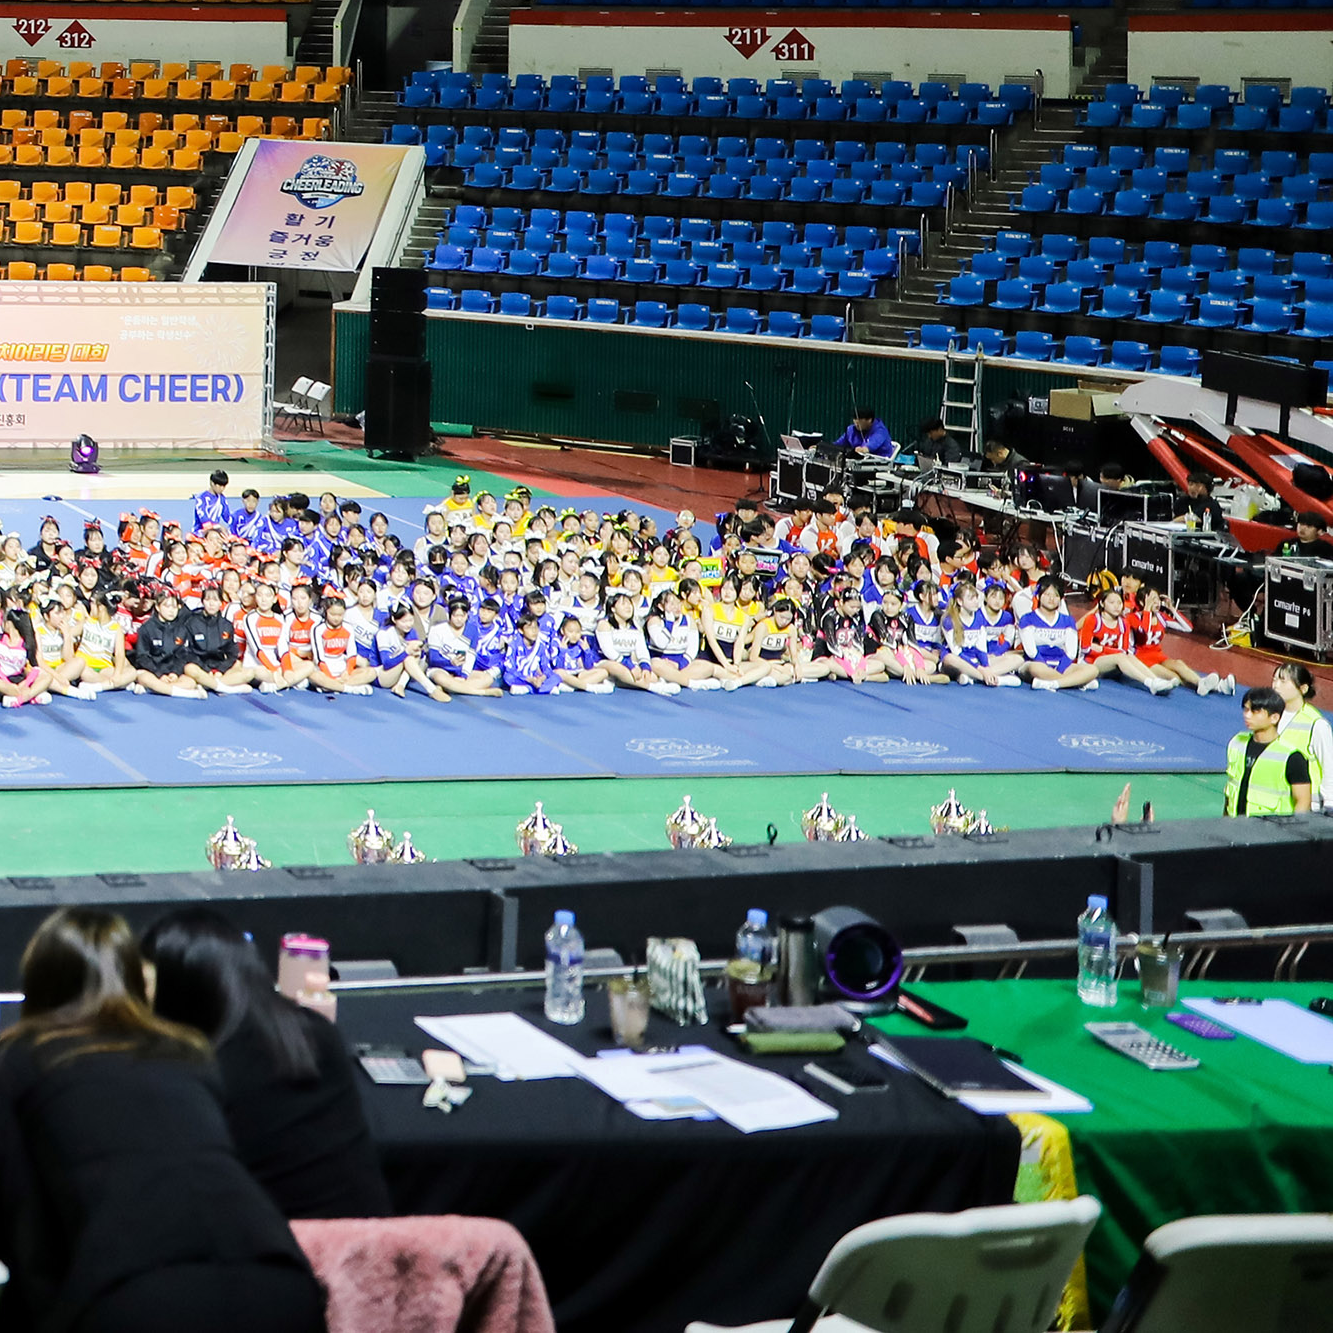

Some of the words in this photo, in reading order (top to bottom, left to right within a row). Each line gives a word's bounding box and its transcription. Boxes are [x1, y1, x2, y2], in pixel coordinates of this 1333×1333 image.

[18, 19, 46, 35] 212
[61, 32, 90, 48] 312
[731, 28, 762, 45] 211
[778, 43, 809, 60] 311
[282, 179, 364, 195] CHEERLEADING
[70, 343, 109, 363] 대회
[118, 372, 246, 404] CHEER)
[1146, 630, 1162, 645] K
